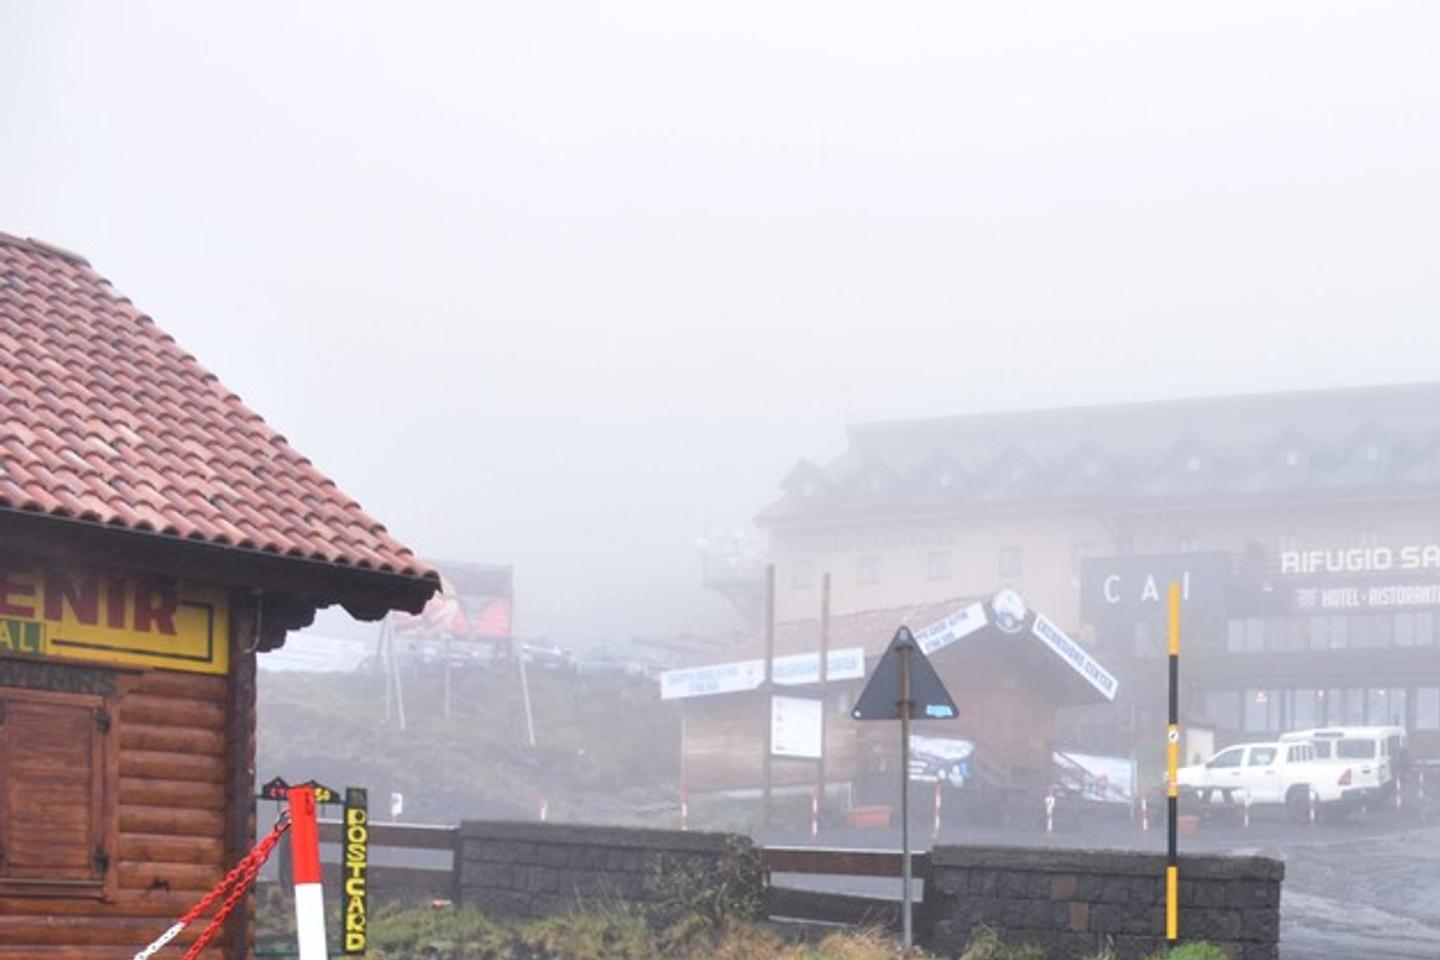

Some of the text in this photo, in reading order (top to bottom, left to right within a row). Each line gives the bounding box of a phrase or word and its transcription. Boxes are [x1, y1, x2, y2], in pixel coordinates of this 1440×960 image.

[1281, 547, 1393, 574] RIFUGIO
[1321, 587, 1360, 608] HOTEL
[345, 809, 368, 951] POSTCARD
